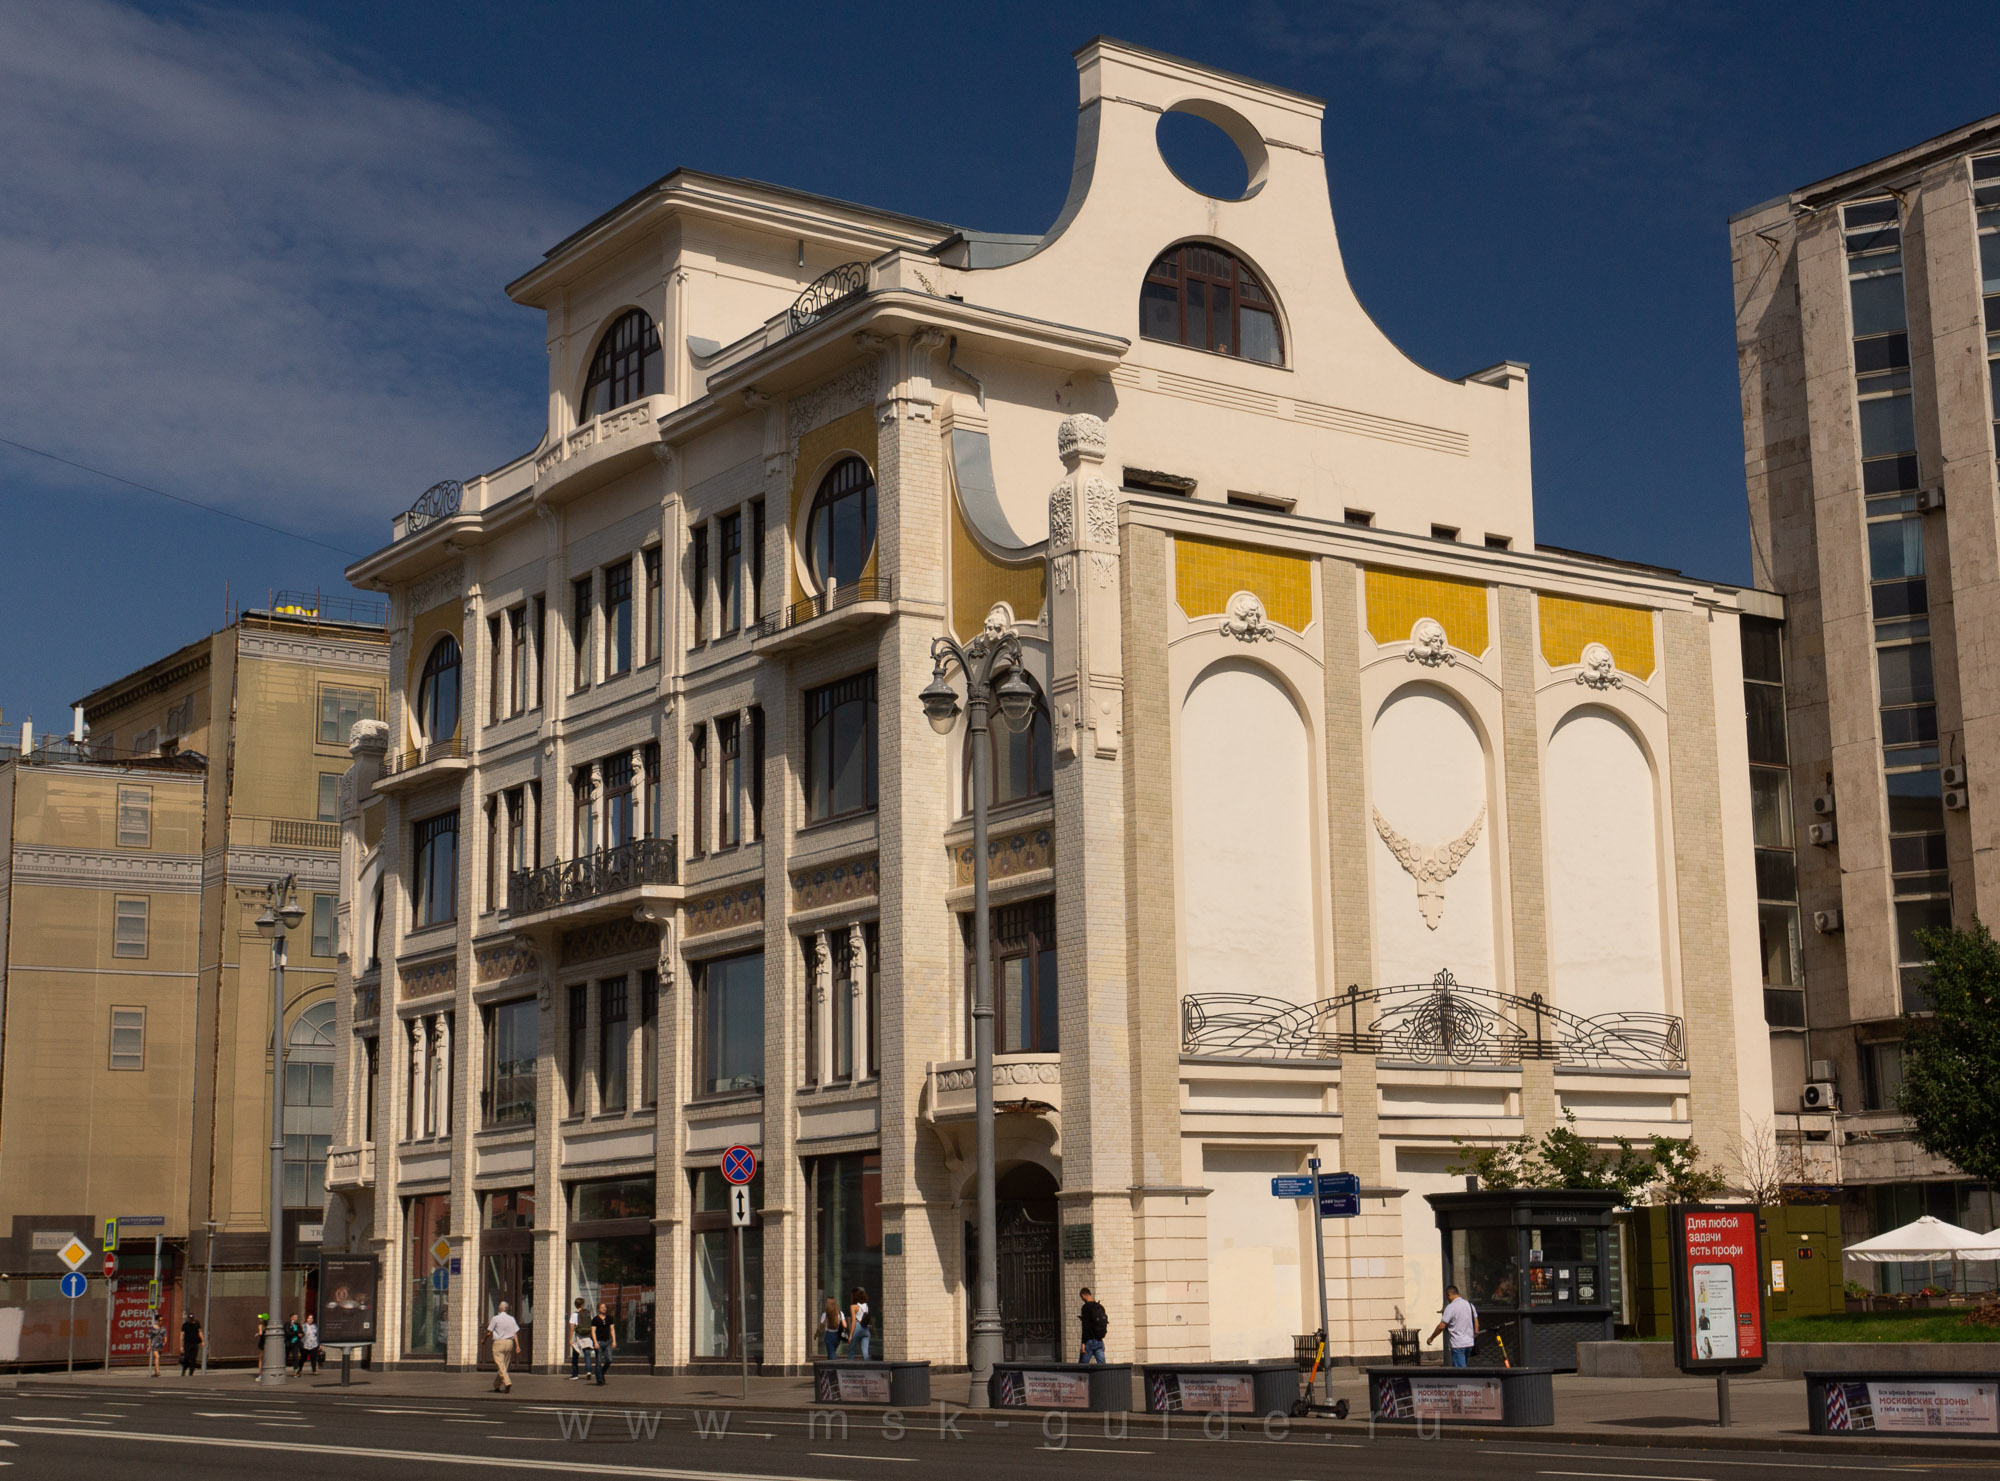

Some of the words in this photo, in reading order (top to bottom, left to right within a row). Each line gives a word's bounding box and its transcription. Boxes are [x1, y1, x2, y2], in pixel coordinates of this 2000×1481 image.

[1687, 1217, 1707, 1230] Для
[1708, 1217, 1739, 1228] любой
[1688, 1233, 1721, 1243] задачи
[1690, 1246, 1711, 1256] есть
[1712, 1244, 1743, 1257] профи
[118, 1319, 154, 1328] ОФИСО
[133, 1329, 145, 1338] 15
[1741, 1348, 1750, 1356] 6+
[1935, 1398, 1969, 1406] СЕЗОНЫ
